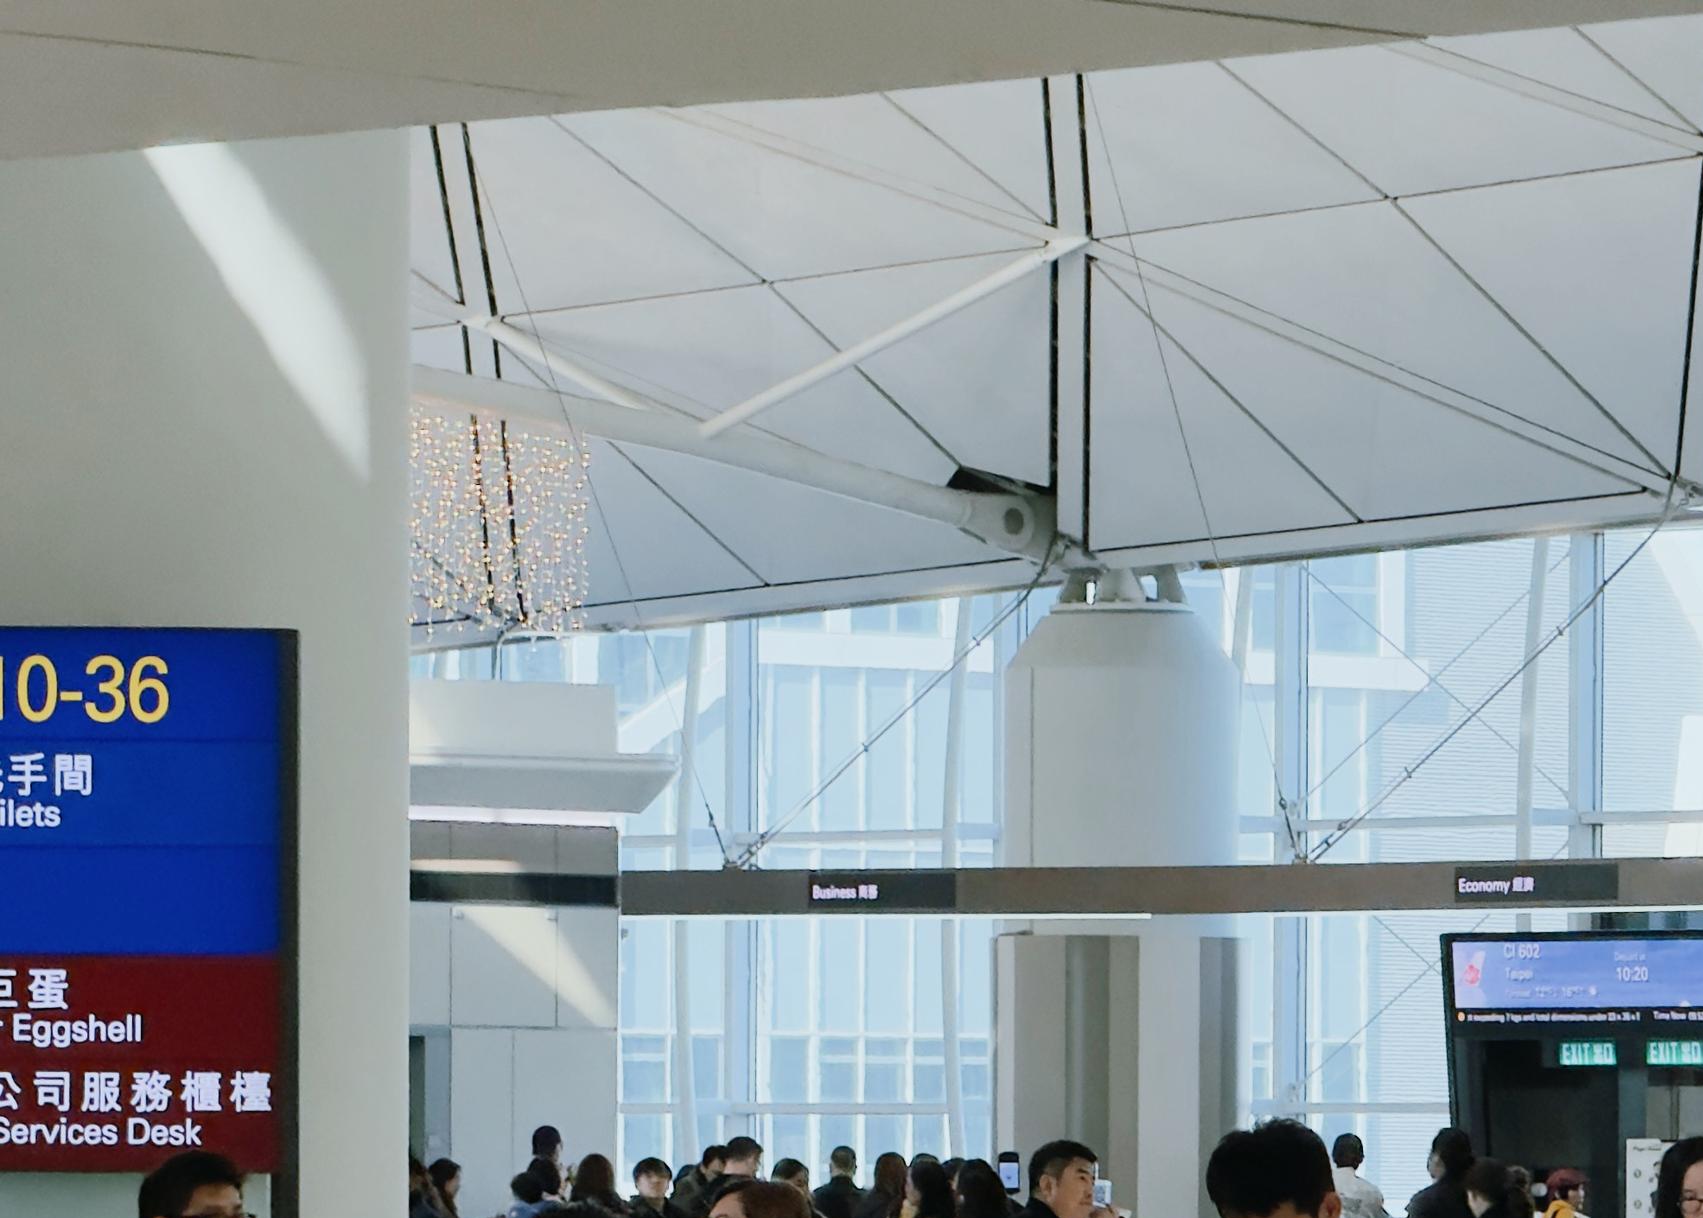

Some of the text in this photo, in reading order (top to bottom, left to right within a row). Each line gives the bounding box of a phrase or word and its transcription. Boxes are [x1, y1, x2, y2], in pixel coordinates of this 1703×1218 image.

[0, 654, 170, 724] 0-36
[0, 752, 92, 796] 手間
[812, 884, 857, 900] Business
[1458, 878, 1511, 896] Economy
[1518, 943, 1541, 959] 602
[1616, 966, 1649, 982] 10:20
[12, 1013, 142, 1047] Eggshell
[1562, 1043, 1591, 1065] EXIT
[1650, 1041, 1678, 1065] EXIT
[127, 1117, 202, 1146] Desk
